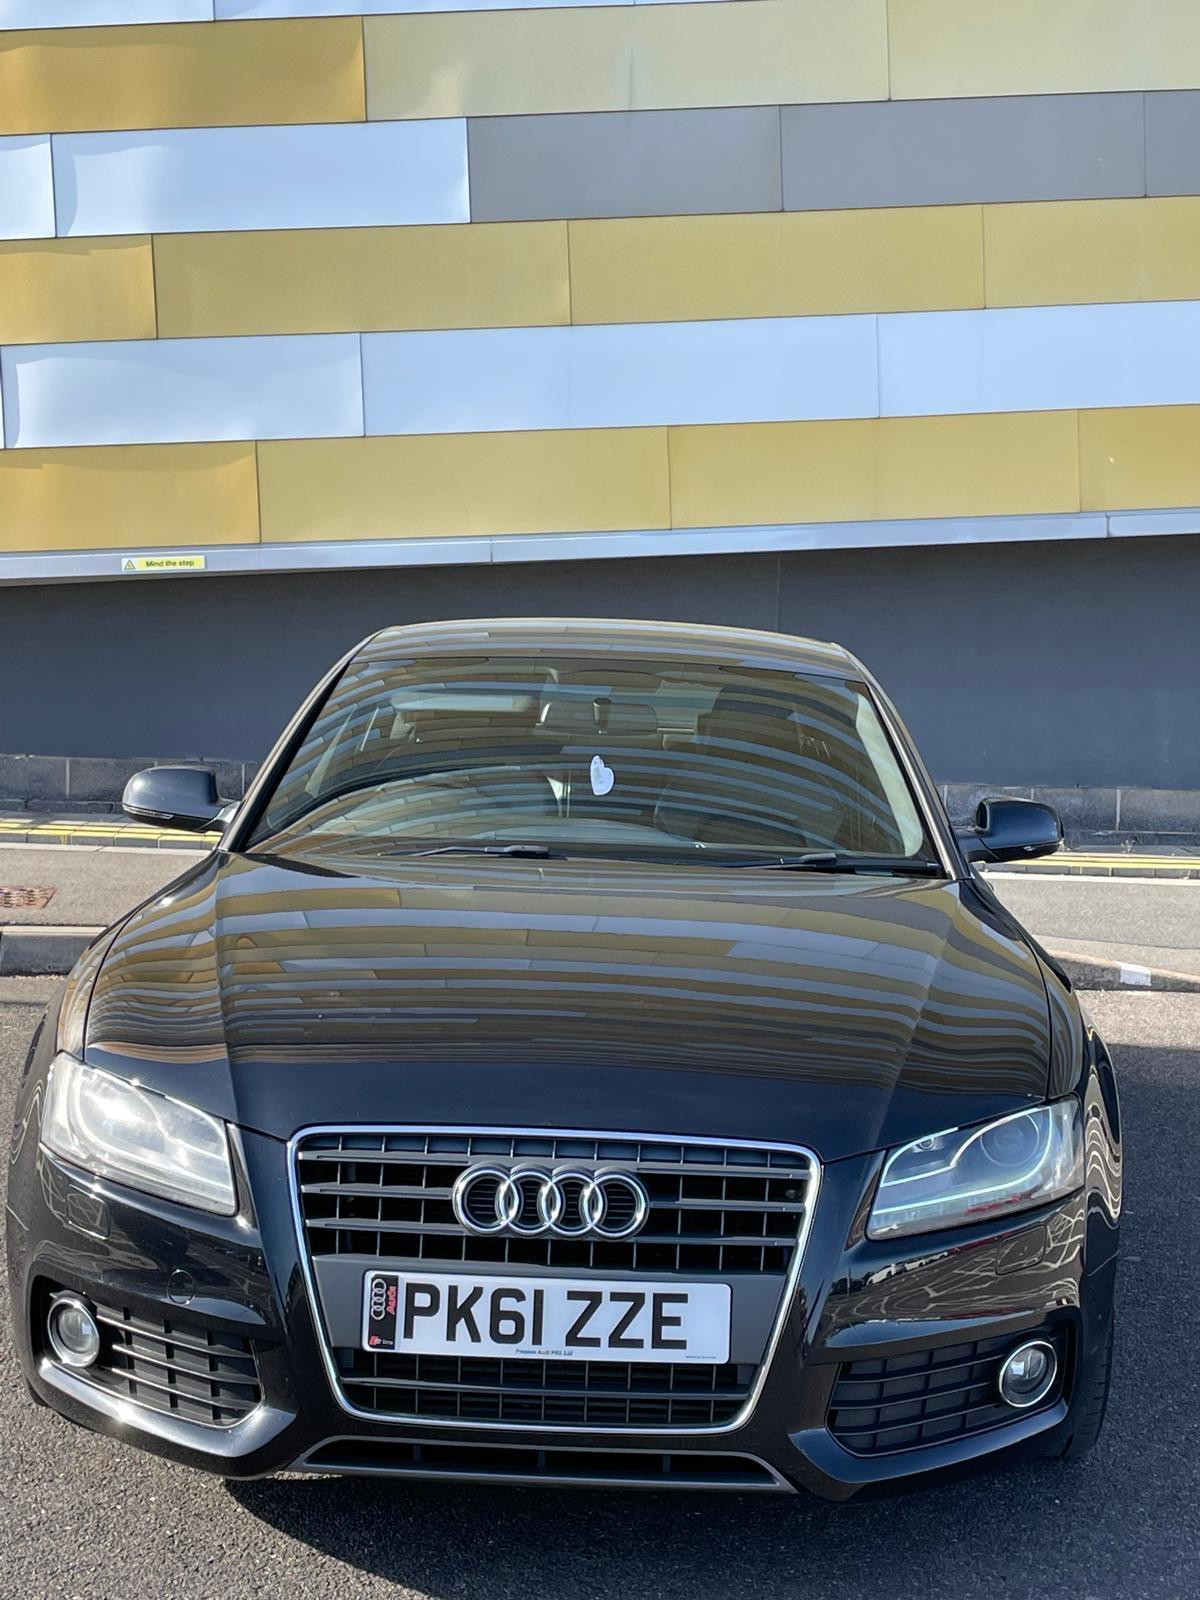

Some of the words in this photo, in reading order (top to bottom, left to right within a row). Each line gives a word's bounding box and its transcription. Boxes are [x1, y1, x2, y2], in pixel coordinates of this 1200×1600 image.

[386, 1286, 397, 1315] Audi
[403, 1282, 544, 1346] PK61
[565, 1290, 689, 1350] ZZE
